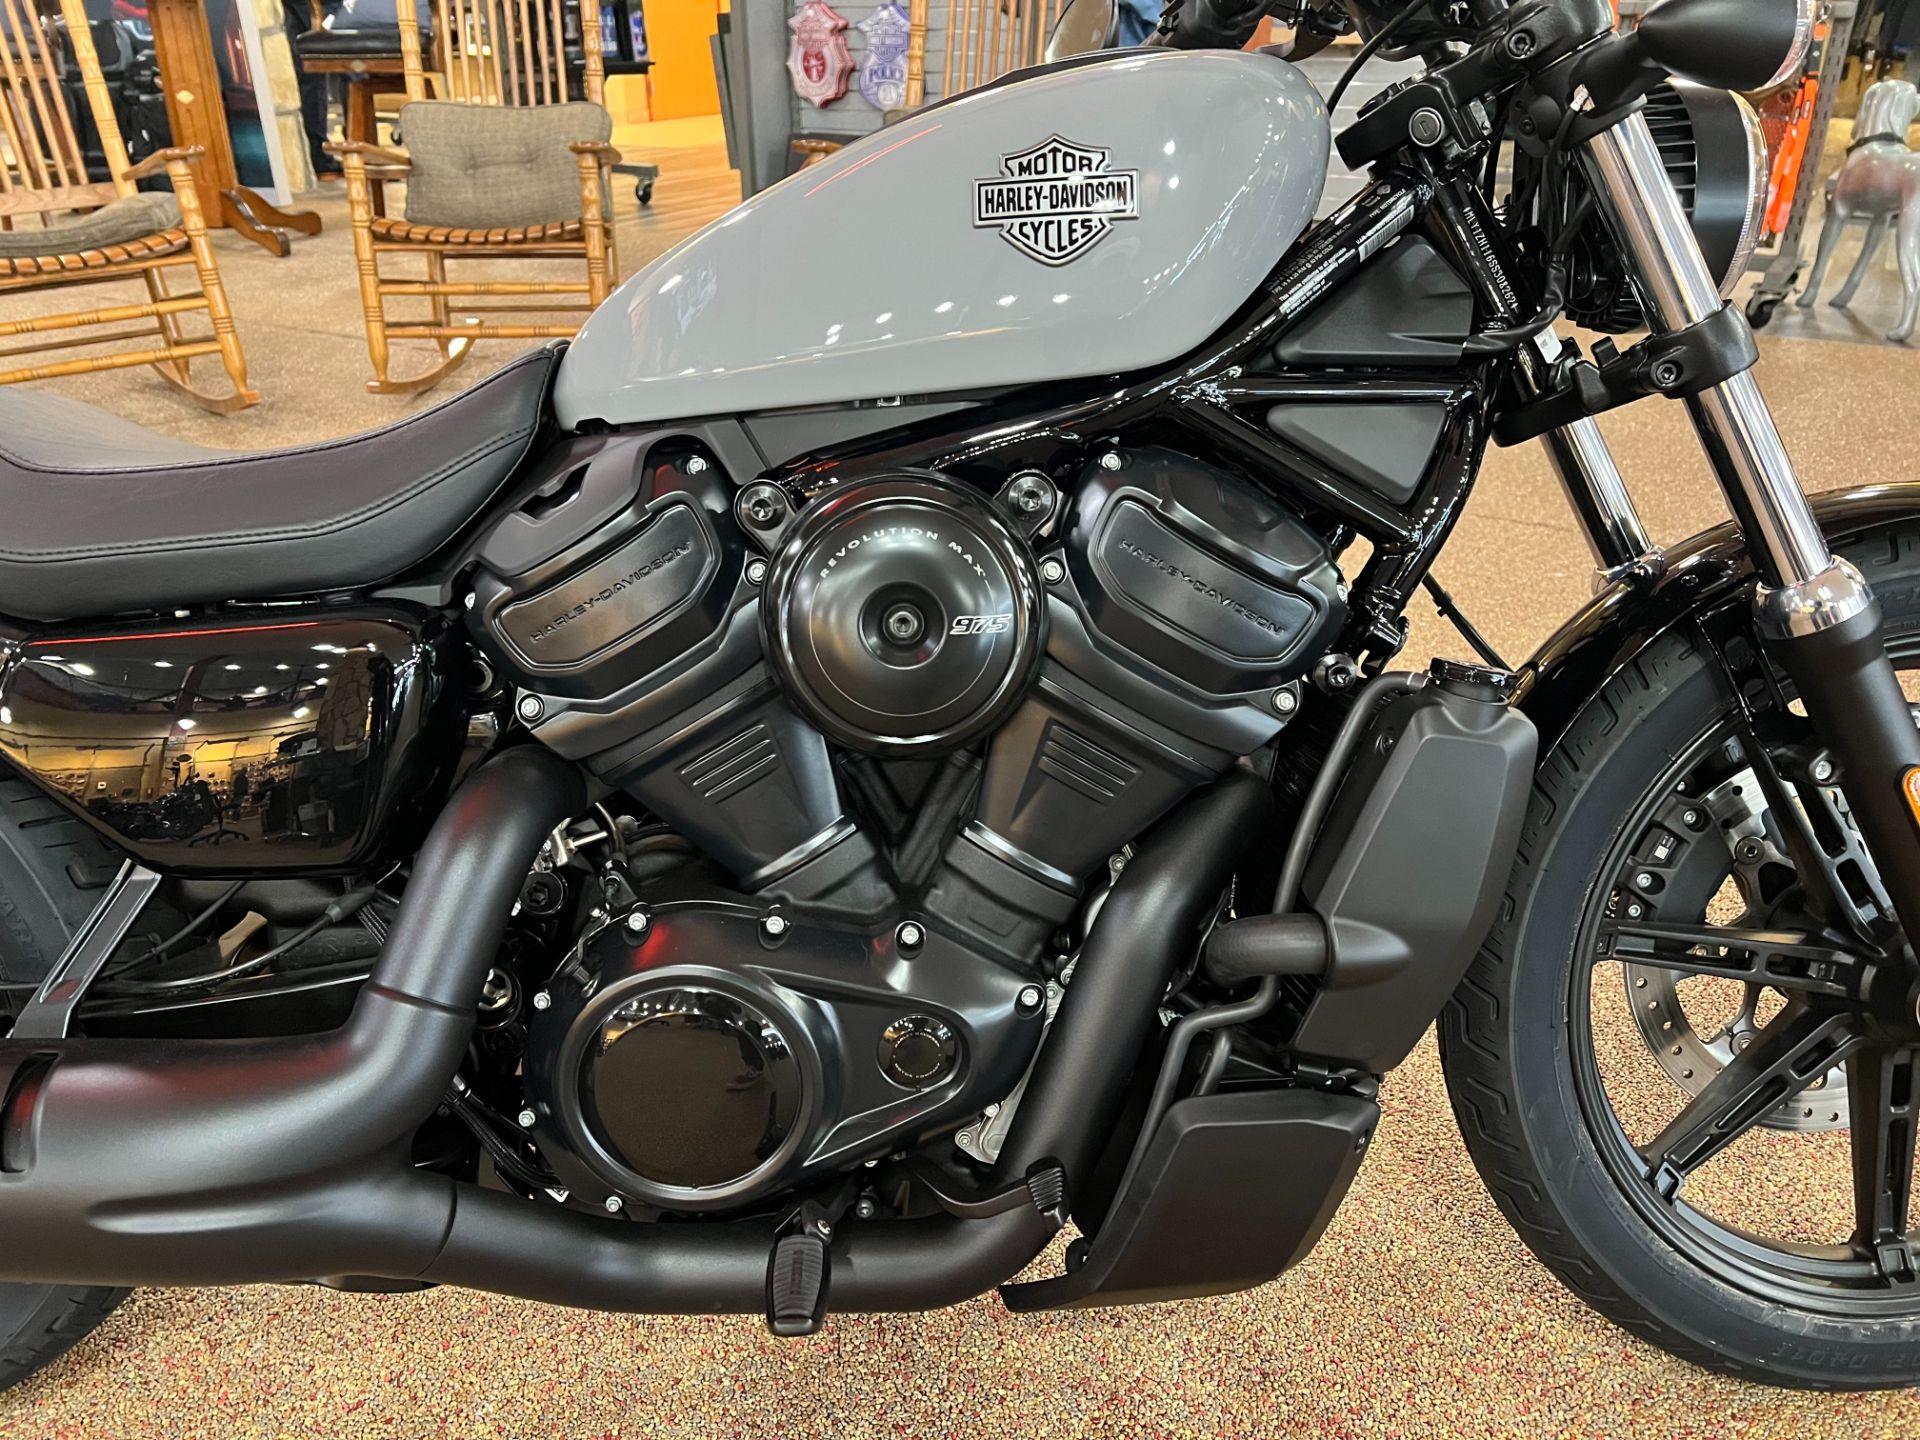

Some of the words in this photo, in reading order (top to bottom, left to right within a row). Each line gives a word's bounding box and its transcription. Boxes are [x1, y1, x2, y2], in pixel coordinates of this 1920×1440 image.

[1018, 146, 1093, 177] MOTOR
[984, 180, 1128, 214] HARLEY-DAVIDSON
[819, 527, 939, 579] REVOLUTION
[948, 541, 986, 577] MAX
[529, 541, 694, 644] HARLEY-DAVIDSON
[1119, 538, 1286, 638] HARLEY-DAVIDSON
[949, 613, 1014, 635] 975
